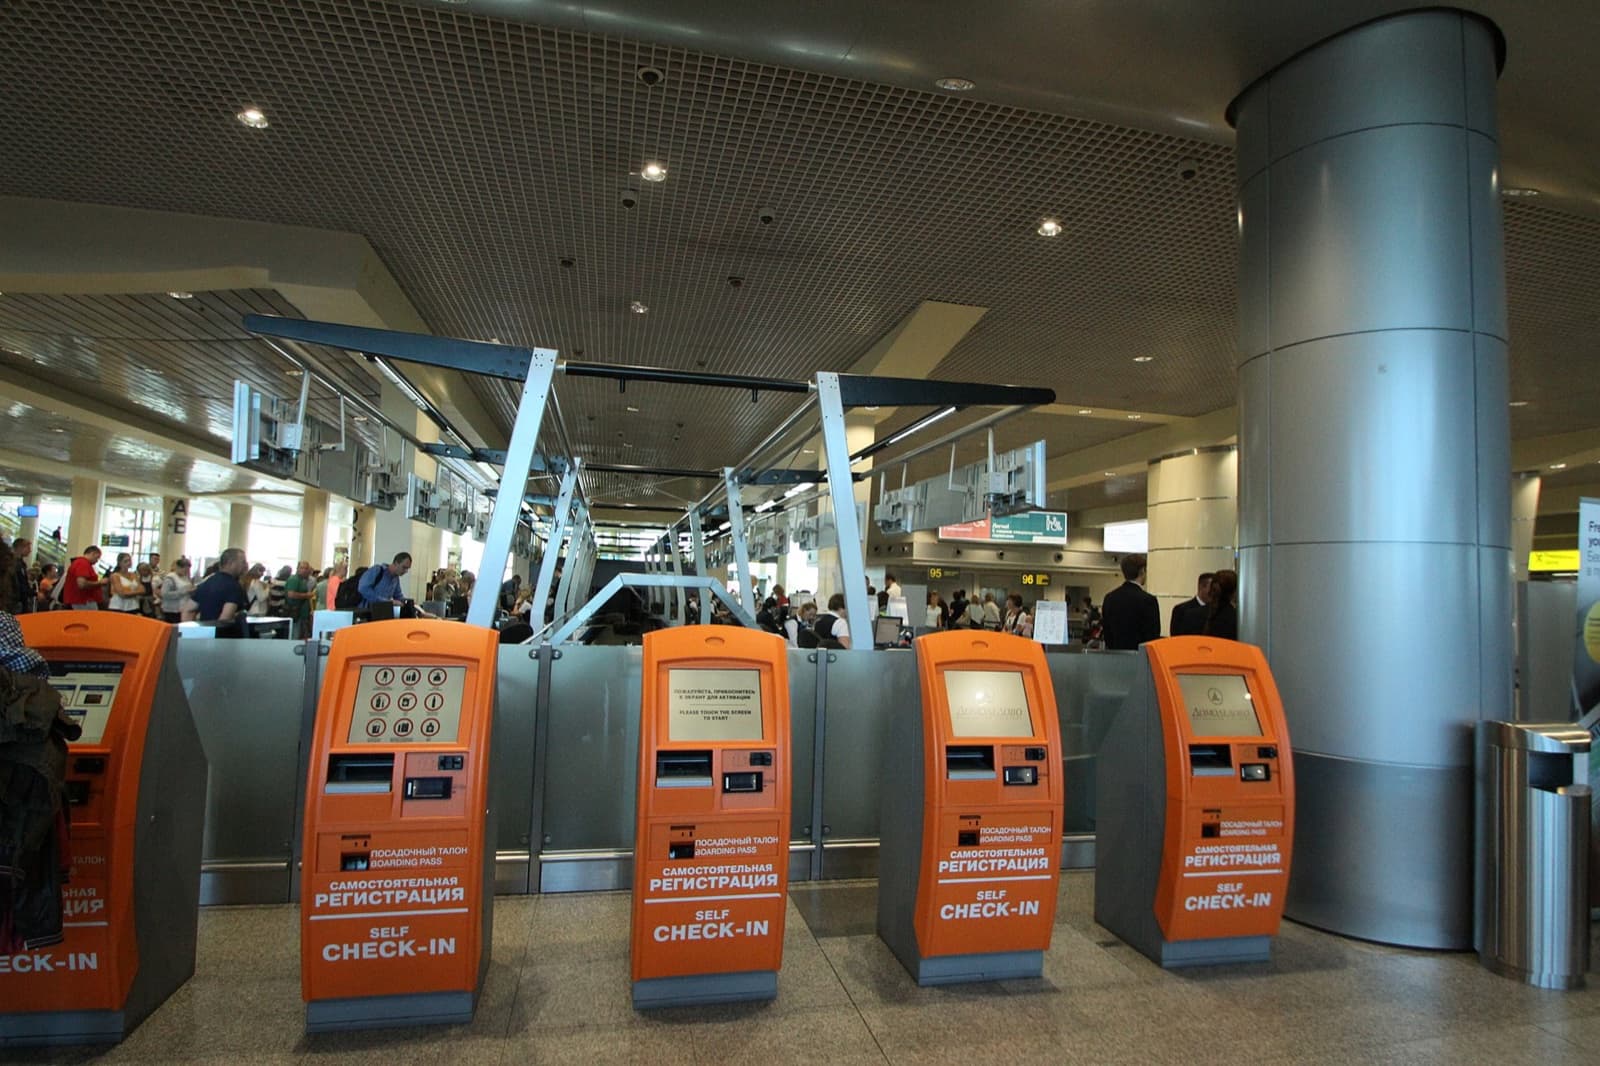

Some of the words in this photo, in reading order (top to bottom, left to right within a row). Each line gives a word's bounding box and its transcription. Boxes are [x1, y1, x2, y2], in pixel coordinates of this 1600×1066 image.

[172, 500, 187, 516] A
[929, 568, 942, 578] 95
[1022, 574, 1034, 585] 96
[694, 837, 752, 847] ПОСАДОЧНЫЙ
[753, 836, 779, 844] ТАЛОН
[370, 846, 436, 858] ПОСАДОЧНЫЙ
[438, 847, 468, 855] ТАЛОН
[694, 847, 736, 856] BOARDING
[737, 846, 757, 854] PASS
[950, 848, 1045, 859] САМОСТОЯТЕЛЬНАЯ
[1195, 844, 1278, 854] САМОСТОЯТЕЛЬНАЯ
[370, 859, 418, 868] BOARDING
[419, 858, 443, 866] PASS
[938, 857, 1049, 873] РЕГИСТРАЦИЯ
[1184, 853, 1281, 868] РЕГИСТРАЦИЯ
[662, 864, 773, 876] САМОСТОЯТЕЛЬНАЯ
[329, 877, 458, 891] САМОСТОЯТЕЛЬНАЯ
[649, 873, 778, 892] РЕГИСТРАЦИЯ
[1217, 882, 1243, 893] SELF
[314, 887, 465, 908] РЕГИСТРАЦИЯ
[976, 890, 1007, 901] SELF
[1184, 892, 1272, 911] CHECK-IN
[695, 909, 730, 921] SELF
[940, 900, 1040, 920] CHECK-IN
[369, 926, 410, 939] SELF
[653, 920, 769, 942] CHECK-IN
[321, 938, 456, 961] CHECK-IN
